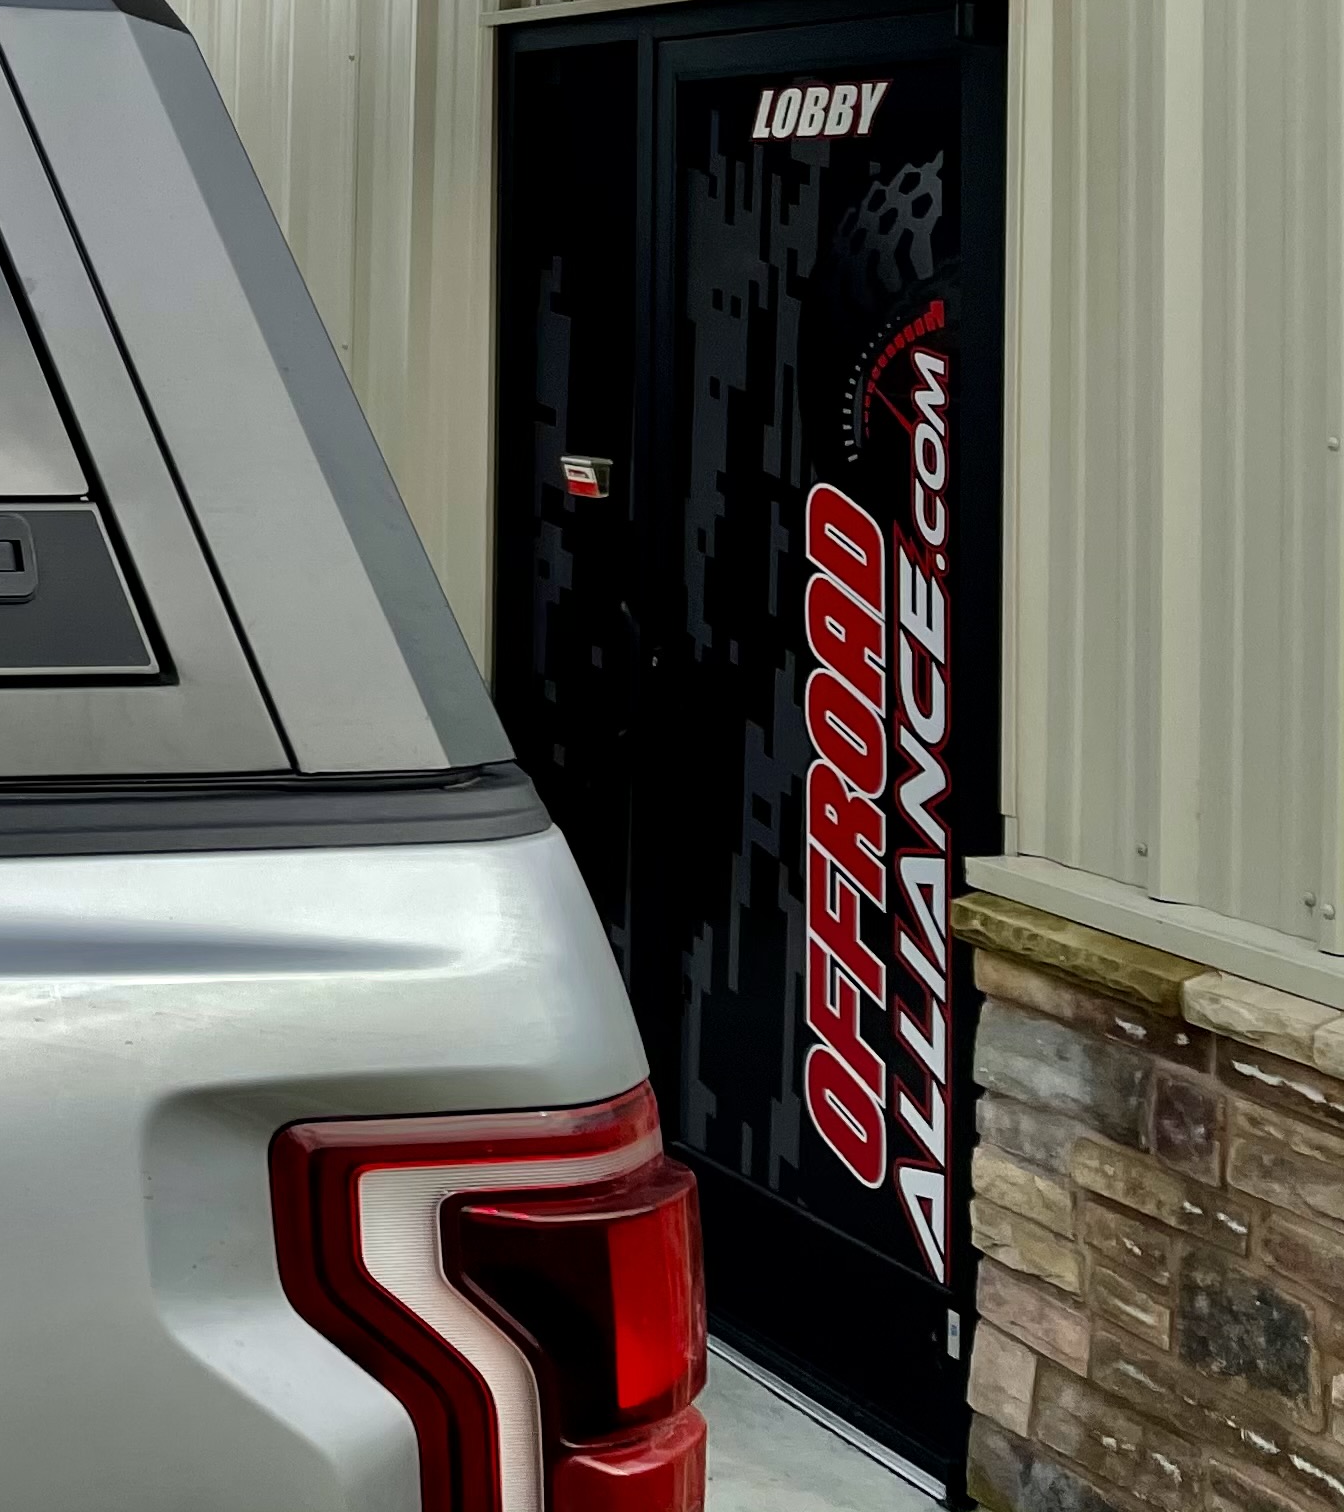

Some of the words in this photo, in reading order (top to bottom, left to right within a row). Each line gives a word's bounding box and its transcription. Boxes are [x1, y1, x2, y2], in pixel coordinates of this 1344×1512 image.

[751, 82, 889, 139] LOBBY
[805, 483, 887, 1189] OFFROAD
[898, 352, 946, 1284] ALLIANCE.COM
